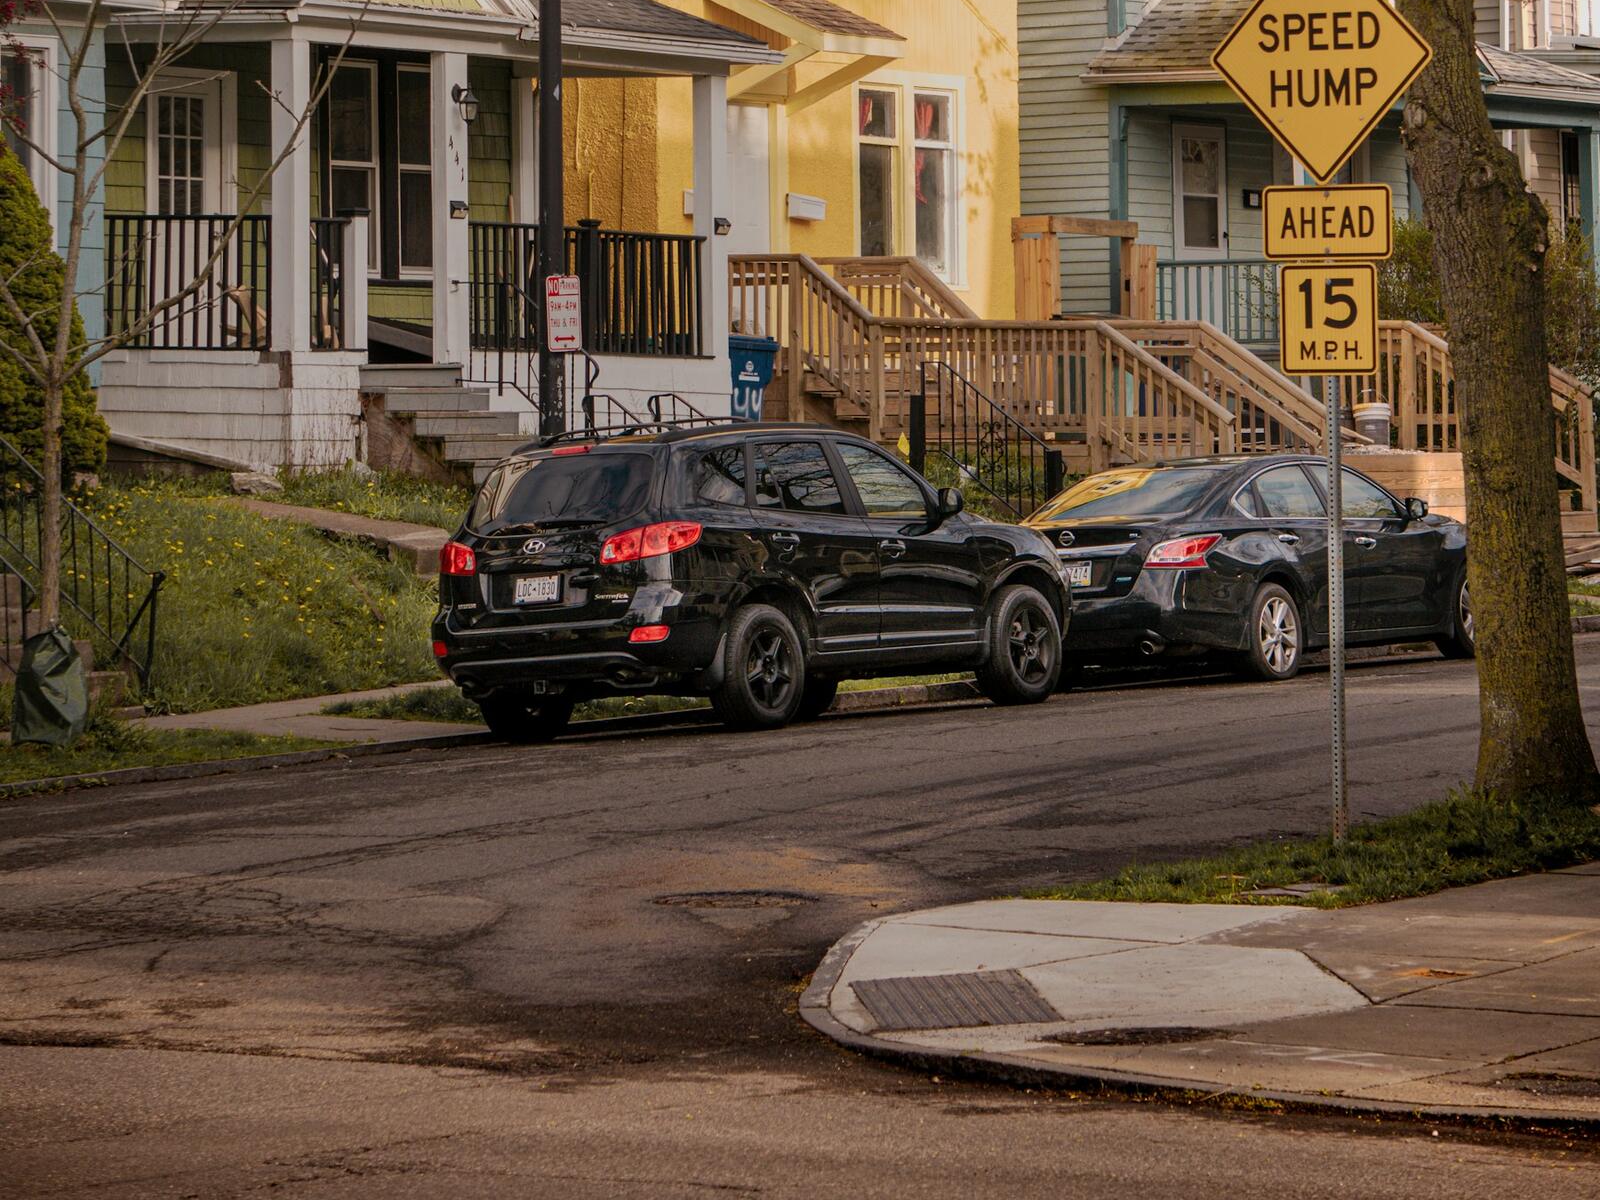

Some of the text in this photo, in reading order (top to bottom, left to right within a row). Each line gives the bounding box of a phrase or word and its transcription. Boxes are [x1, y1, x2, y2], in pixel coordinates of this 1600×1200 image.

[1258, 10, 1380, 53] SPEED
[1270, 67, 1378, 108] HUMP
[1281, 205, 1375, 239] AHEAD
[548, 279, 559, 294] NO
[1298, 277, 1358, 330] 15
[550, 318, 561, 328] THU
[569, 317, 578, 327] FRI
[1299, 339, 1364, 361] M.P.H.
